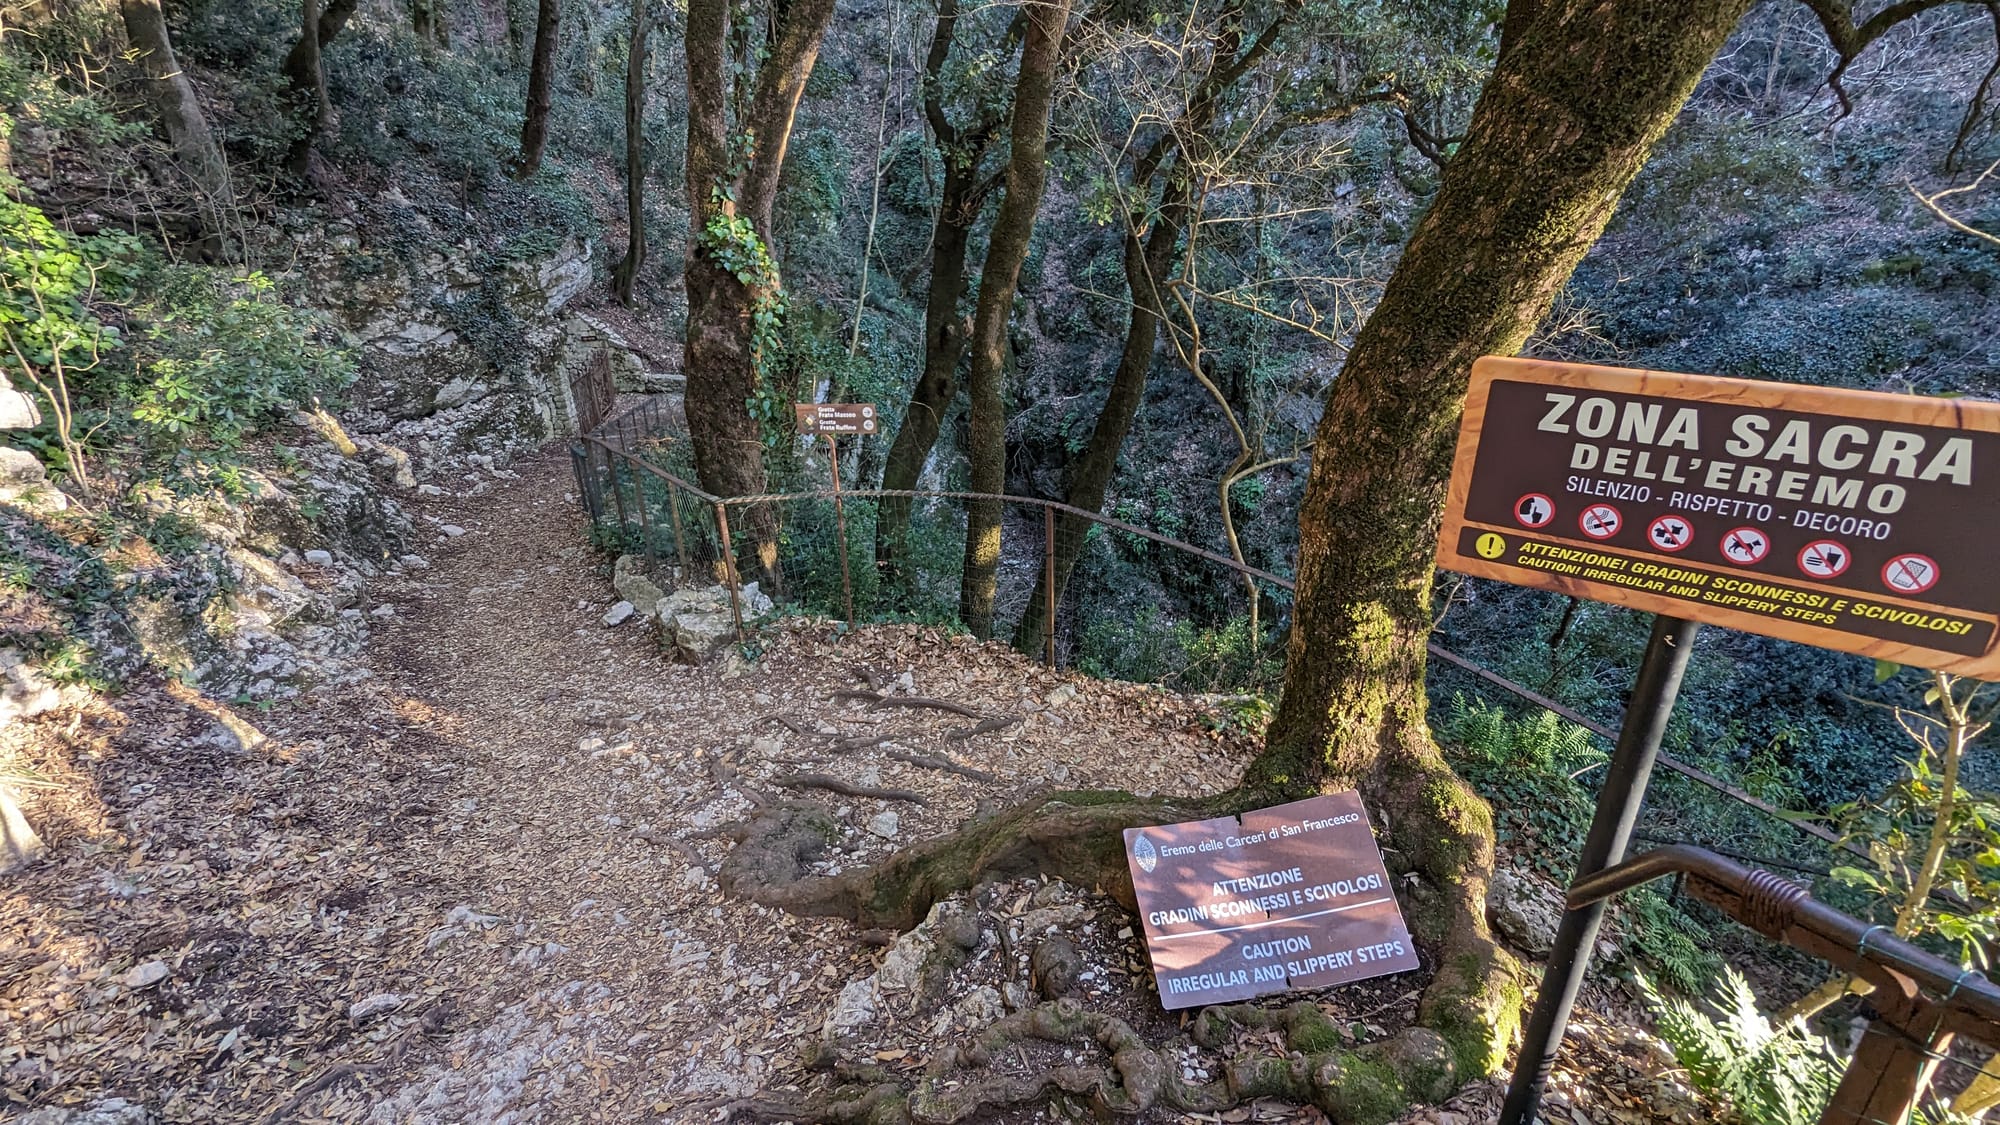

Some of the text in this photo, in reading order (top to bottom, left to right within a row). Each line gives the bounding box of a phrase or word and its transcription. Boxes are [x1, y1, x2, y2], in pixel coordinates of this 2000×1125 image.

[1537, 392, 1974, 486] ZONA SACRA
[1566, 476, 1651, 503] SILENZIO
[1670, 490, 1772, 522] RISPETTO
[1793, 509, 1891, 541] DECORO
[1517, 555, 1838, 626] CAUTION! IRREGULAR AND SLIPPERY STEPS
[1520, 542, 1973, 636] ATTENZIONE! GRADINI SCONNESSI E SCIVOLOSI
[1161, 811, 1359, 858] Eremo delle Carceri di San Francesco
[1149, 873, 1382, 926] GRADINI SCONNESSI E SCIVOLOSI
[1212, 867, 1303, 897] ATTENZIONE
[1168, 940, 1404, 994] IRREGULAR AND SLIPPERY STEPS
[1242, 934, 1312, 960] CAUTION
